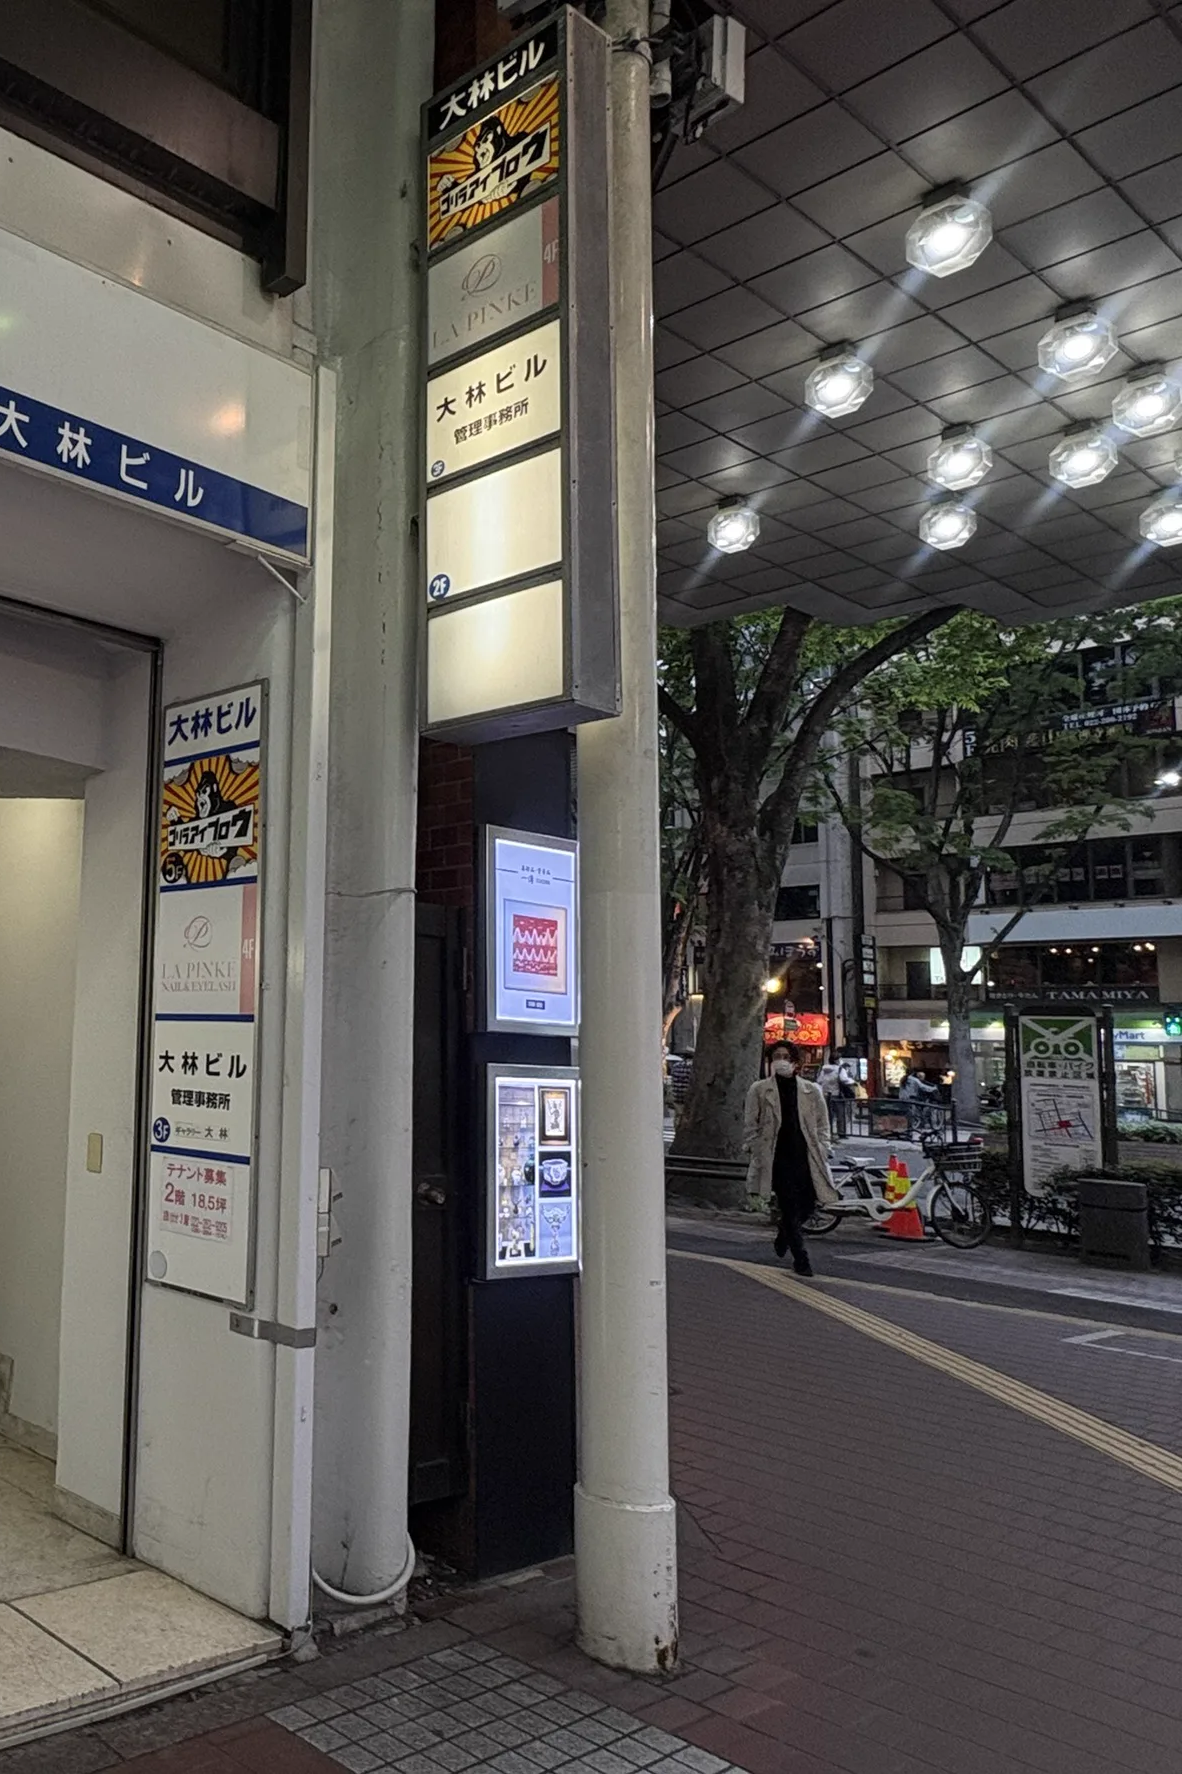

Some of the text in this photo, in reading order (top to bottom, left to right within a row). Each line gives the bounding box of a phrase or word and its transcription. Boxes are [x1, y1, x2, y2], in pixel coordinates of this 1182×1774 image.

[439, 40, 545, 131] 大林ビル
[436, 354, 547, 423] 大林ビル
[453, 397, 530, 445] 管理事務所
[432, 462, 445, 476] 3F
[432, 577, 447, 598] 2F
[168, 697, 257, 746] 大林ビル
[166, 857, 183, 881] 5F
[242, 938, 255, 960] 4F
[158, 1050, 247, 1079] 大林ビル
[171, 1088, 231, 1111] 管理事務所
[154, 1120, 169, 1140] 3F
[166, 1163, 227, 1187] テナント募集
[164, 1182, 186, 1206] 2階
